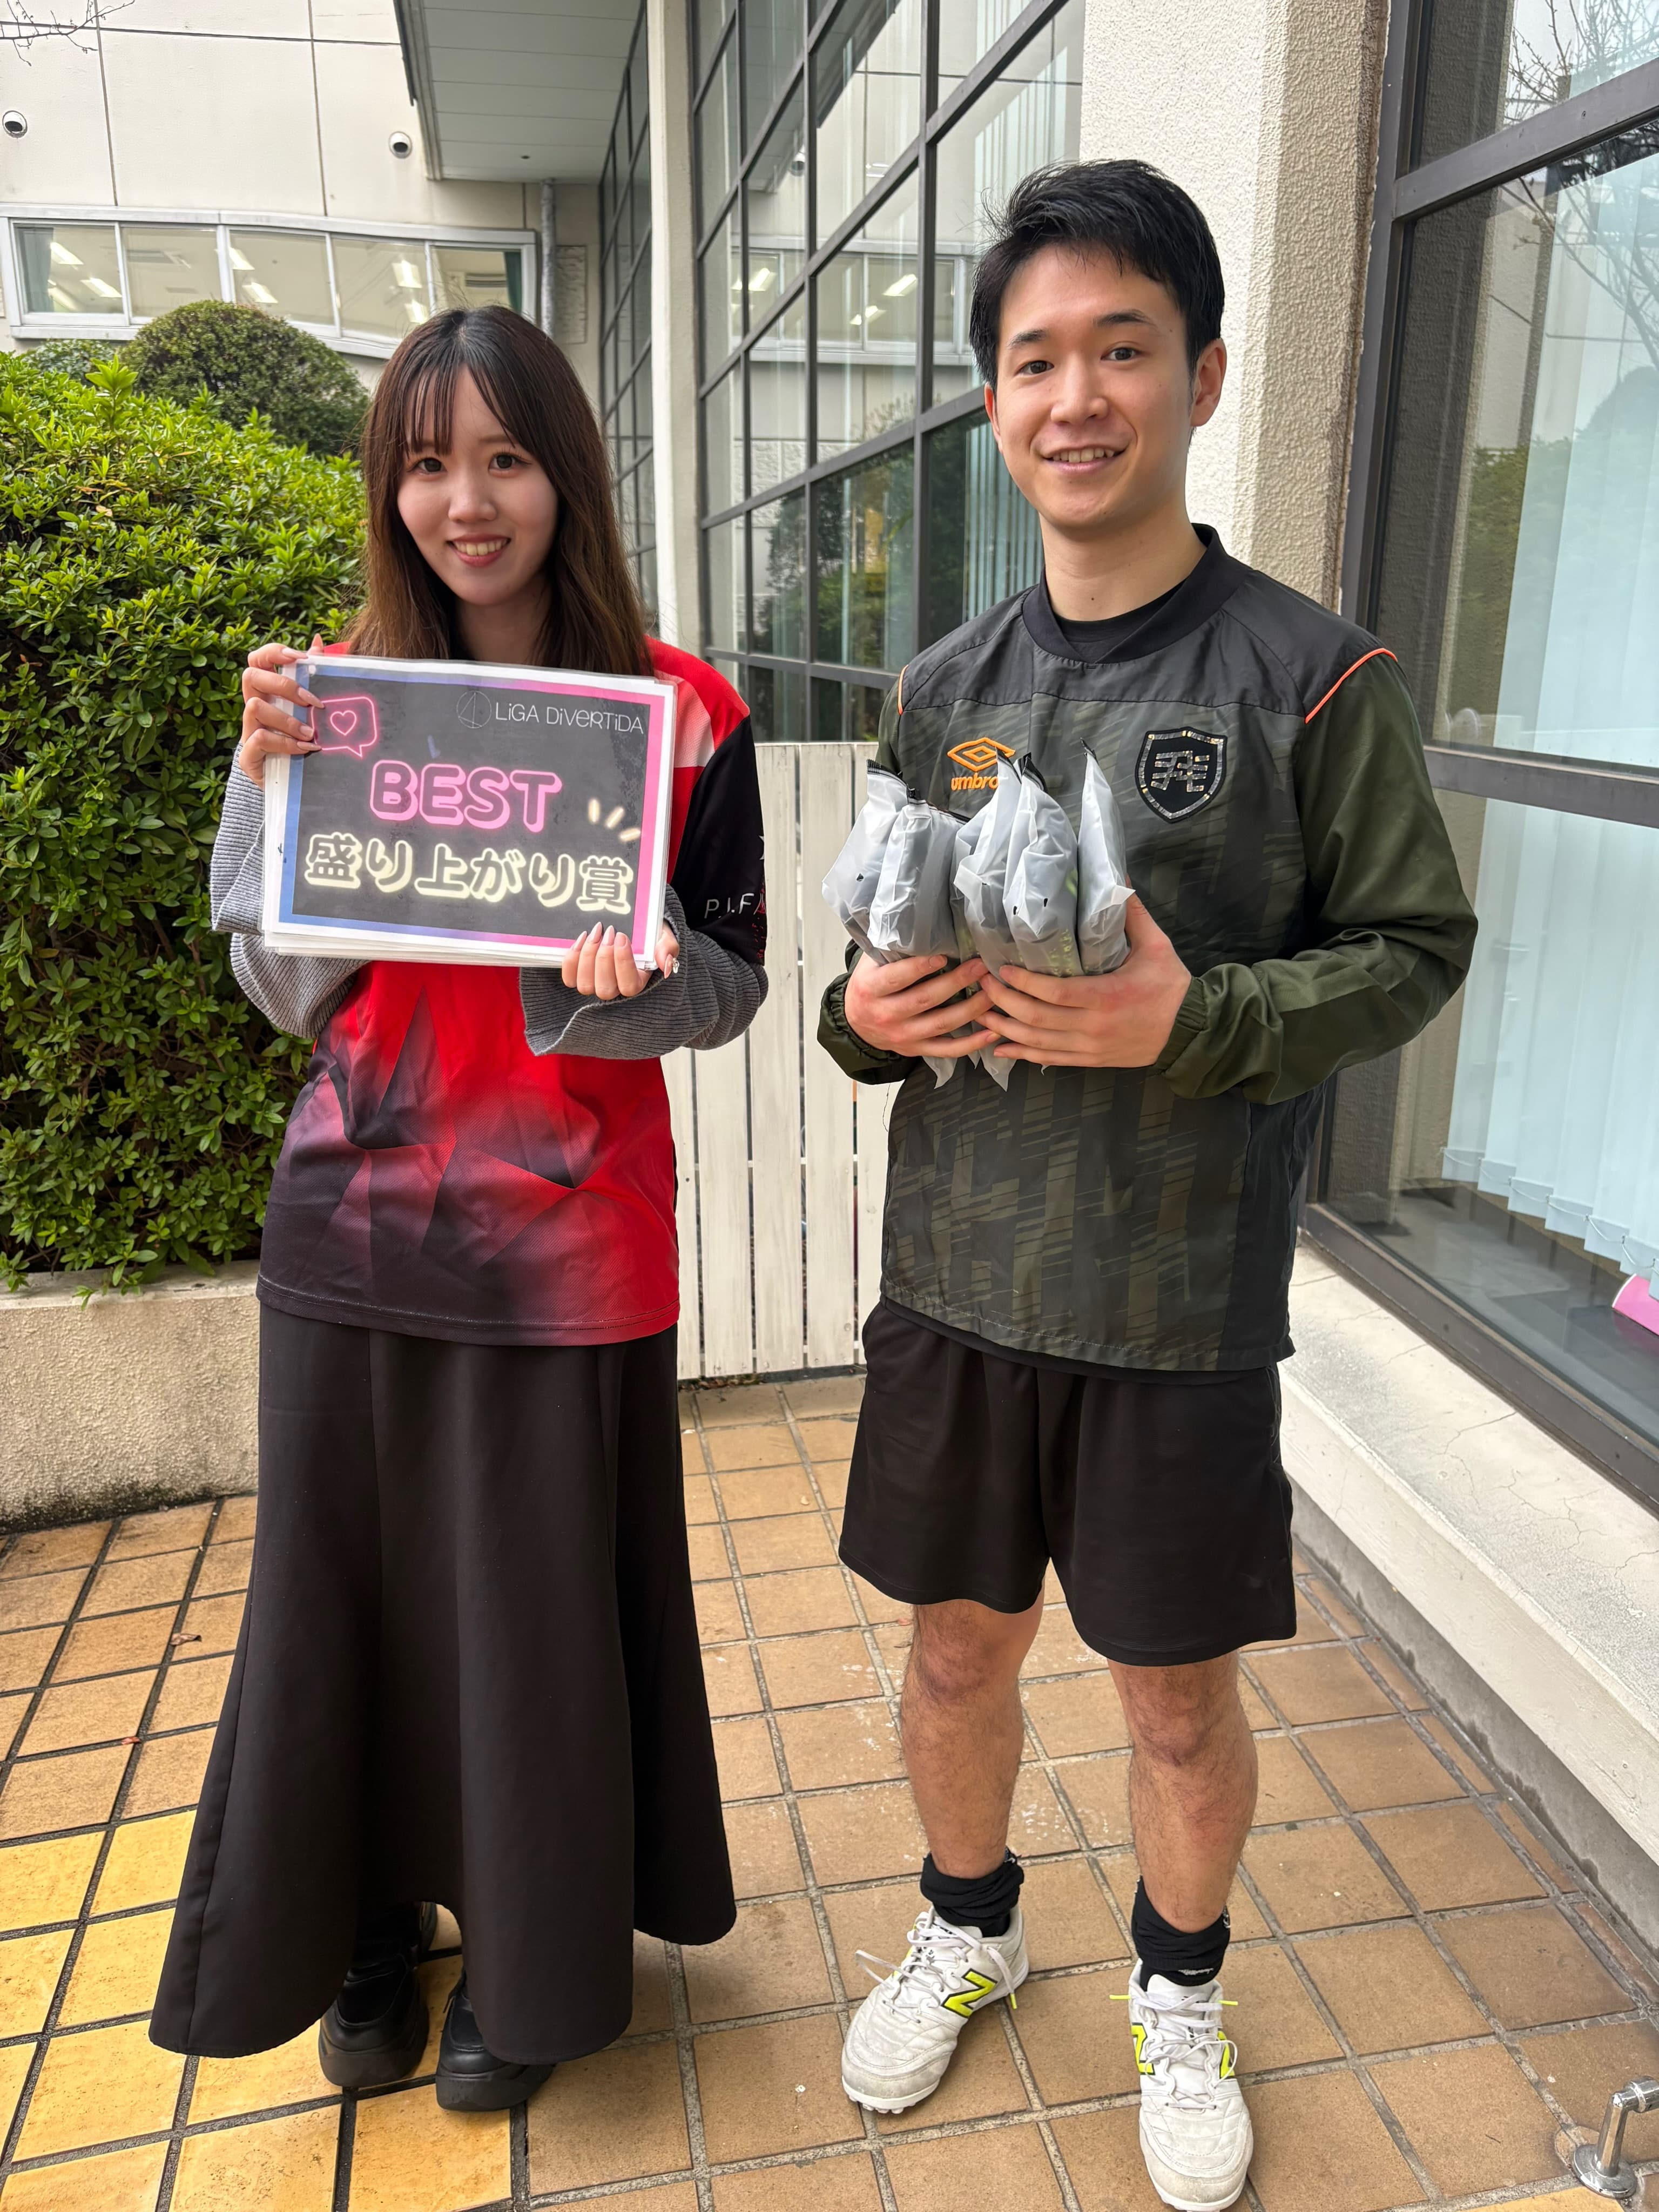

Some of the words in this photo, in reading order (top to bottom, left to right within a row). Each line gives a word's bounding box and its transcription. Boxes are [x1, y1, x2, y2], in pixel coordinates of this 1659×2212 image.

[369, 759, 562, 833] BEST
[951, 772, 999, 791] umbro
[305, 832, 633, 915] 盛り上がり賞
